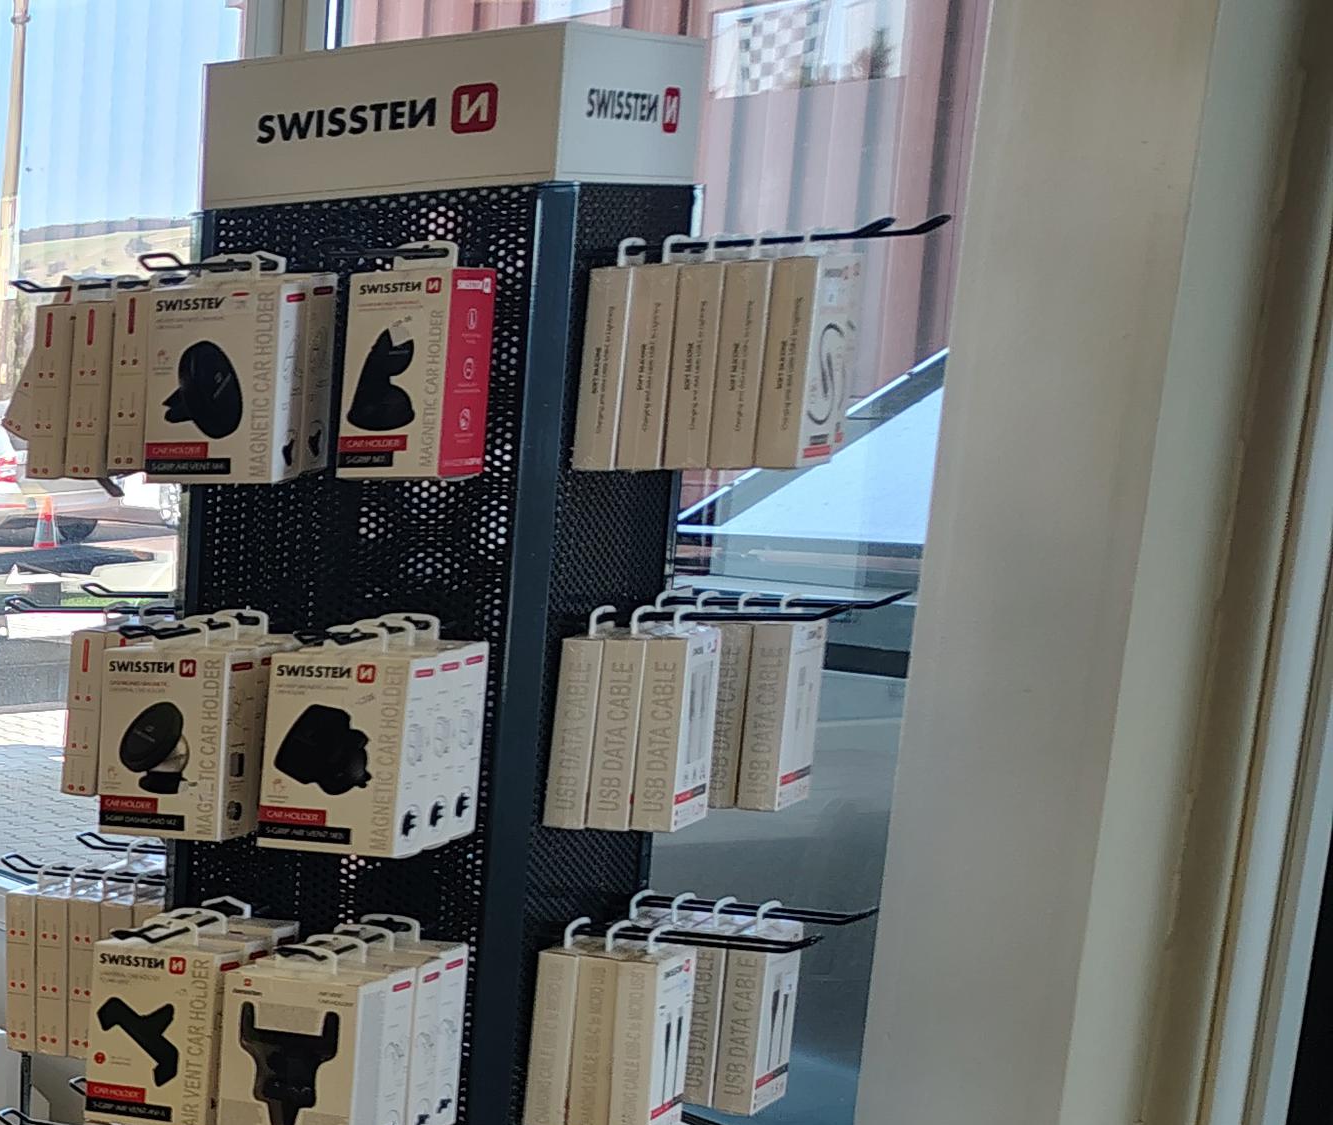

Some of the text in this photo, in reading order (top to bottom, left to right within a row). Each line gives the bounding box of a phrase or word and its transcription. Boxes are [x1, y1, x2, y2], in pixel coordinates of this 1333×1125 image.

[257, 97, 436, 144] SWISSTEN
[587, 88, 658, 122] SWISSTEN
[359, 282, 421, 295] SWISSTEN
[249, 292, 274, 477] MAGNETIC CAR HOLDER
[420, 310, 443, 466] MAGNETIC CAR HOLDER
[109, 660, 174, 674] SWISSTEN
[204, 660, 220, 720] HOLDER
[277, 664, 351, 679] SWISSTEN
[199, 725, 217, 755] CAR
[556, 663, 592, 810] USB DATA CABLE
[597, 662, 633, 811] USB DATA CABLE
[642, 662, 677, 812] USB DATA CABLE
[712, 645, 741, 790] USB DATA CABLE
[746, 648, 783, 794] USB DATA CABLE
[371, 665, 404, 850] MAGNETIC CAR HOLDER
[105, 799, 151, 808] CAR HOLDER
[284, 812, 319, 820] HOLDER
[100, 952, 164, 970] SWISSTEN
[191, 960, 209, 1020] HOLDER
[187, 1026, 204, 1056] CAR
[685, 952, 713, 1088] USB DATA CABLE
[724, 958, 757, 1096] USB DATA CABLE
[185, 1060, 202, 1097] VENT
